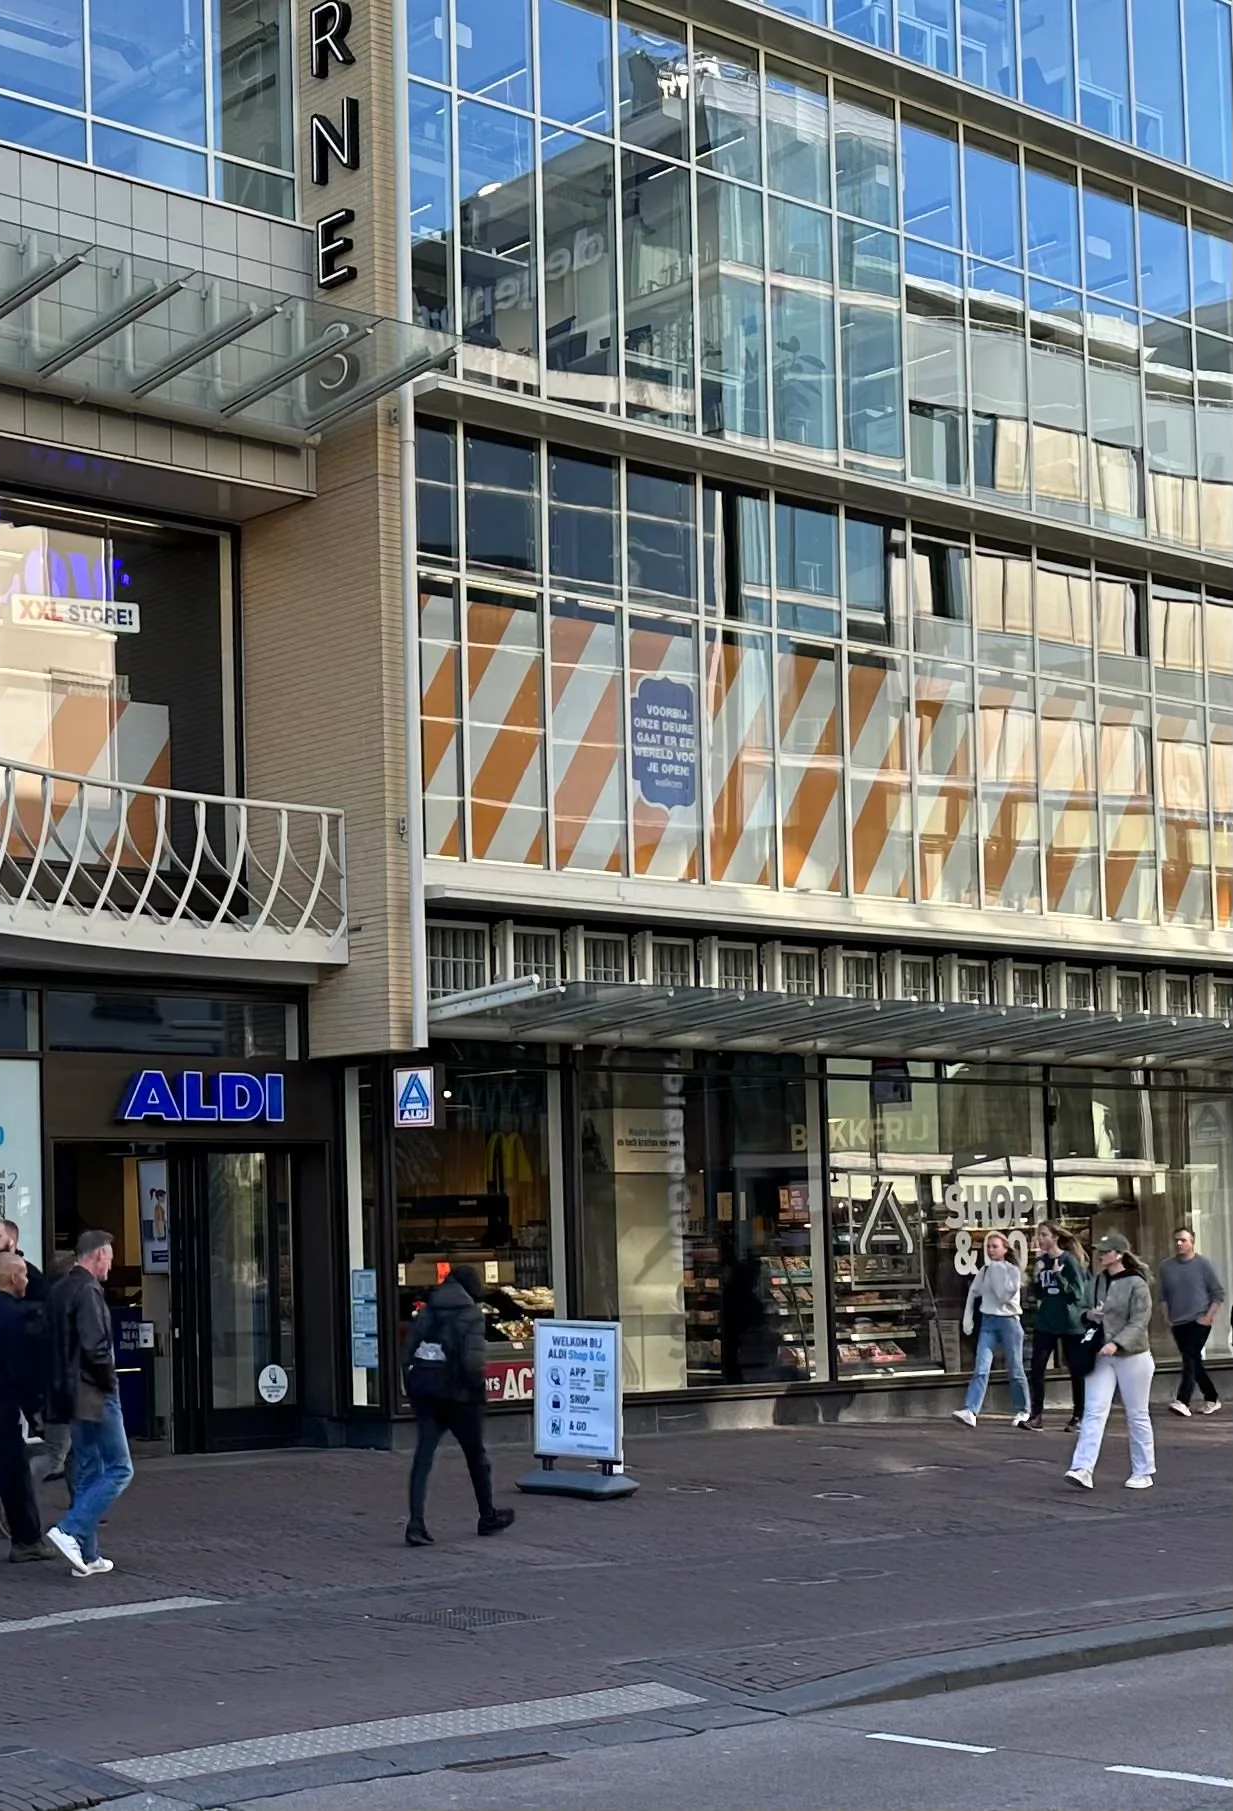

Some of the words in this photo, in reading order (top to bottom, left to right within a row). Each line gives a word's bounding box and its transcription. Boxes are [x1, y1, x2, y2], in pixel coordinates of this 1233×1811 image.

[20, 599, 64, 622] XXL
[68, 605, 133, 626] STORE!
[646, 704, 688, 720] VOORBIJ
[633, 717, 660, 730] ONZE
[662, 721, 695, 734] DEURE
[636, 732, 661, 745] GAAT
[664, 736, 677, 747] ER
[633, 745, 674, 760] WERELD
[676, 751, 695, 764] VOO
[647, 762, 659, 773] JE
[124, 1069, 285, 1122] ALDI
[401, 1109, 428, 1120] ALDI
[790, 1113, 929, 1151] BKKERIJ
[945, 1183, 1034, 1229] SHOP
[551, 1336, 588, 1347] WELKOM
[589, 1337, 603, 1349] BIJ
[548, 1348, 567, 1359] ALDI
[568, 1349, 588, 1363] Shop
[569, 1367, 587, 1377] APP
[569, 1393, 590, 1405] SHOP
[576, 1421, 587, 1431] GO
